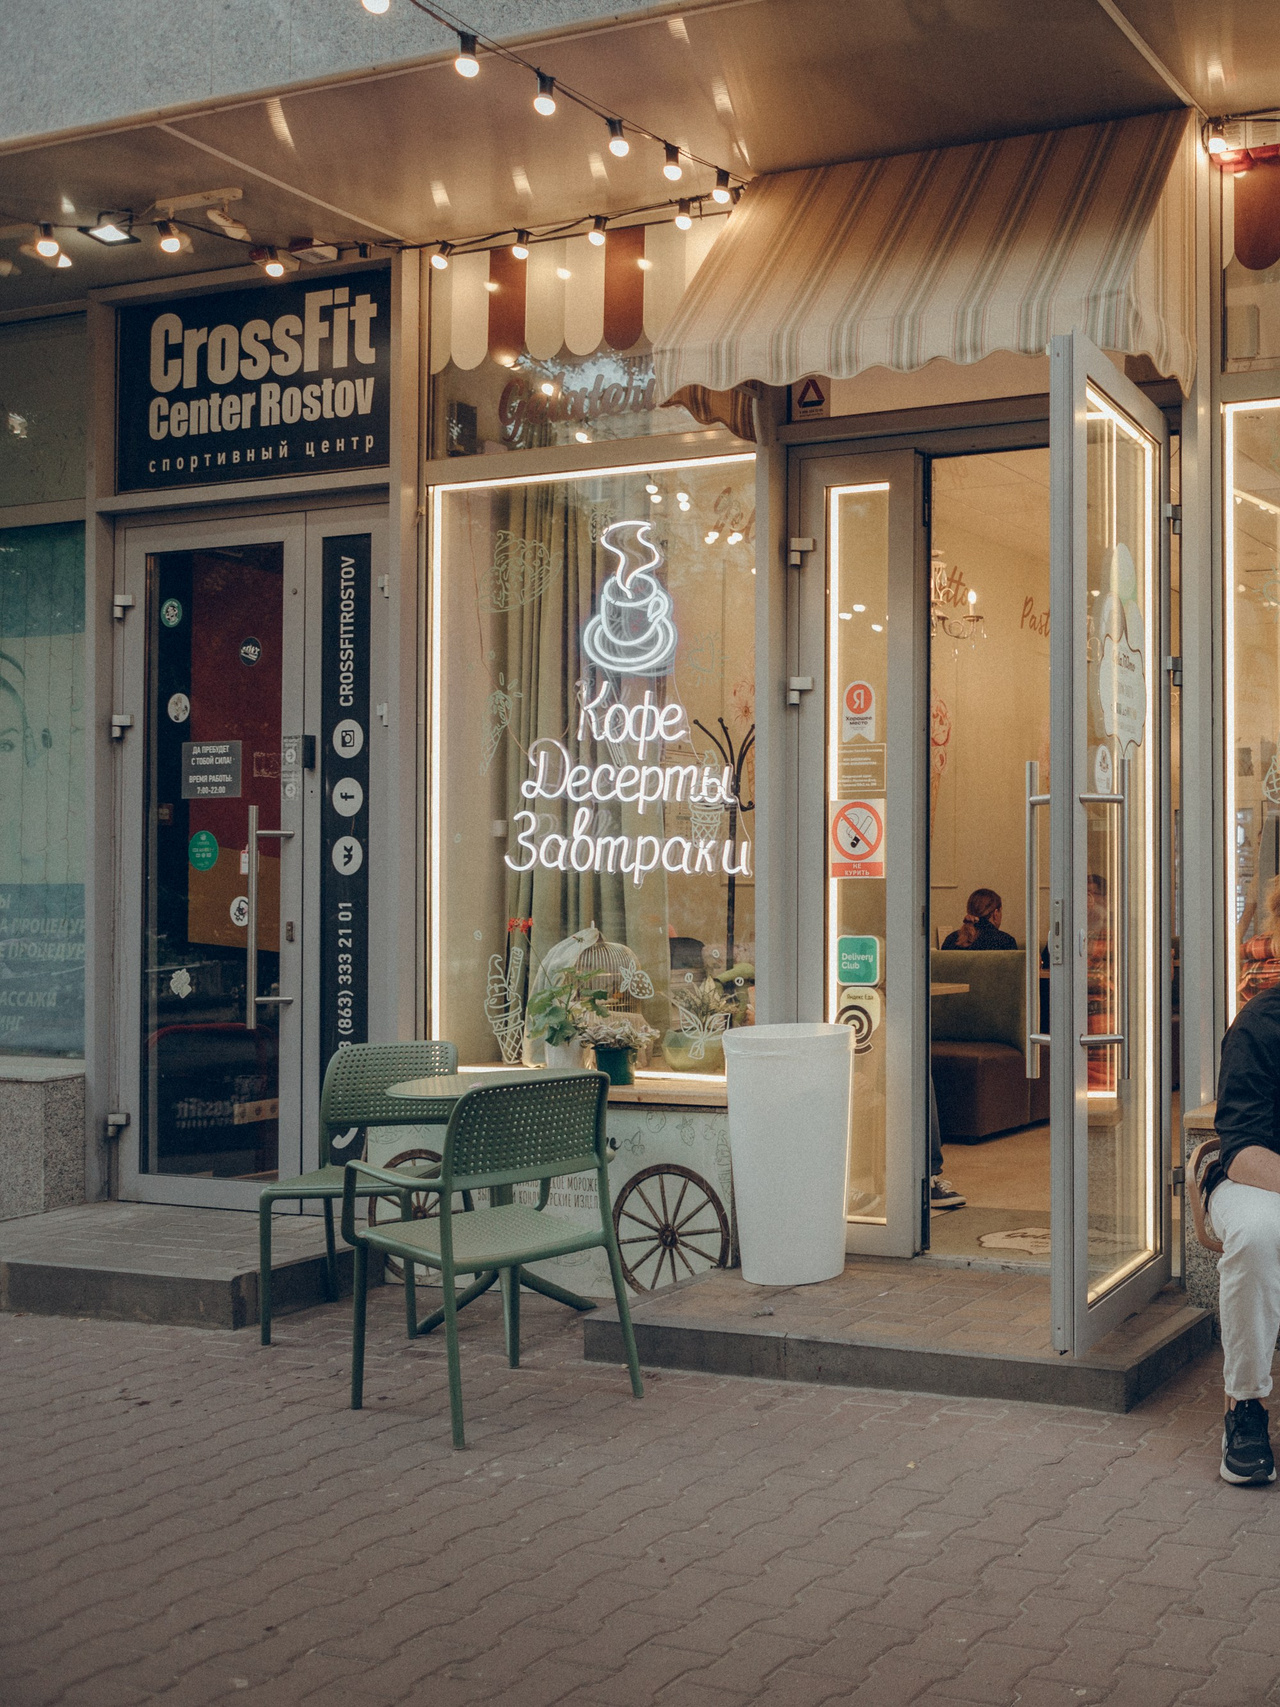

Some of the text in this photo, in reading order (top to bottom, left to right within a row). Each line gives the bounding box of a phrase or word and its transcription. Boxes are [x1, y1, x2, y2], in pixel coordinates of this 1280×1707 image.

[150, 286, 378, 393] CrossFit
[149, 377, 375, 441] Center Rostov
[149, 434, 375, 473] спортивный центр
[339, 555, 355, 707] CROSSFITROSTOV
[577, 681, 687, 761] Кофе
[521, 737, 735, 815] Десерты
[504, 806, 752, 885] Завтраки
[338, 902, 352, 921] 01
[338, 929, 352, 948] 21
[842, 953, 873, 963] Delivery
[338, 953, 352, 985] 333
[841, 961, 860, 969] Club
[338, 990, 353, 1035] (863)
